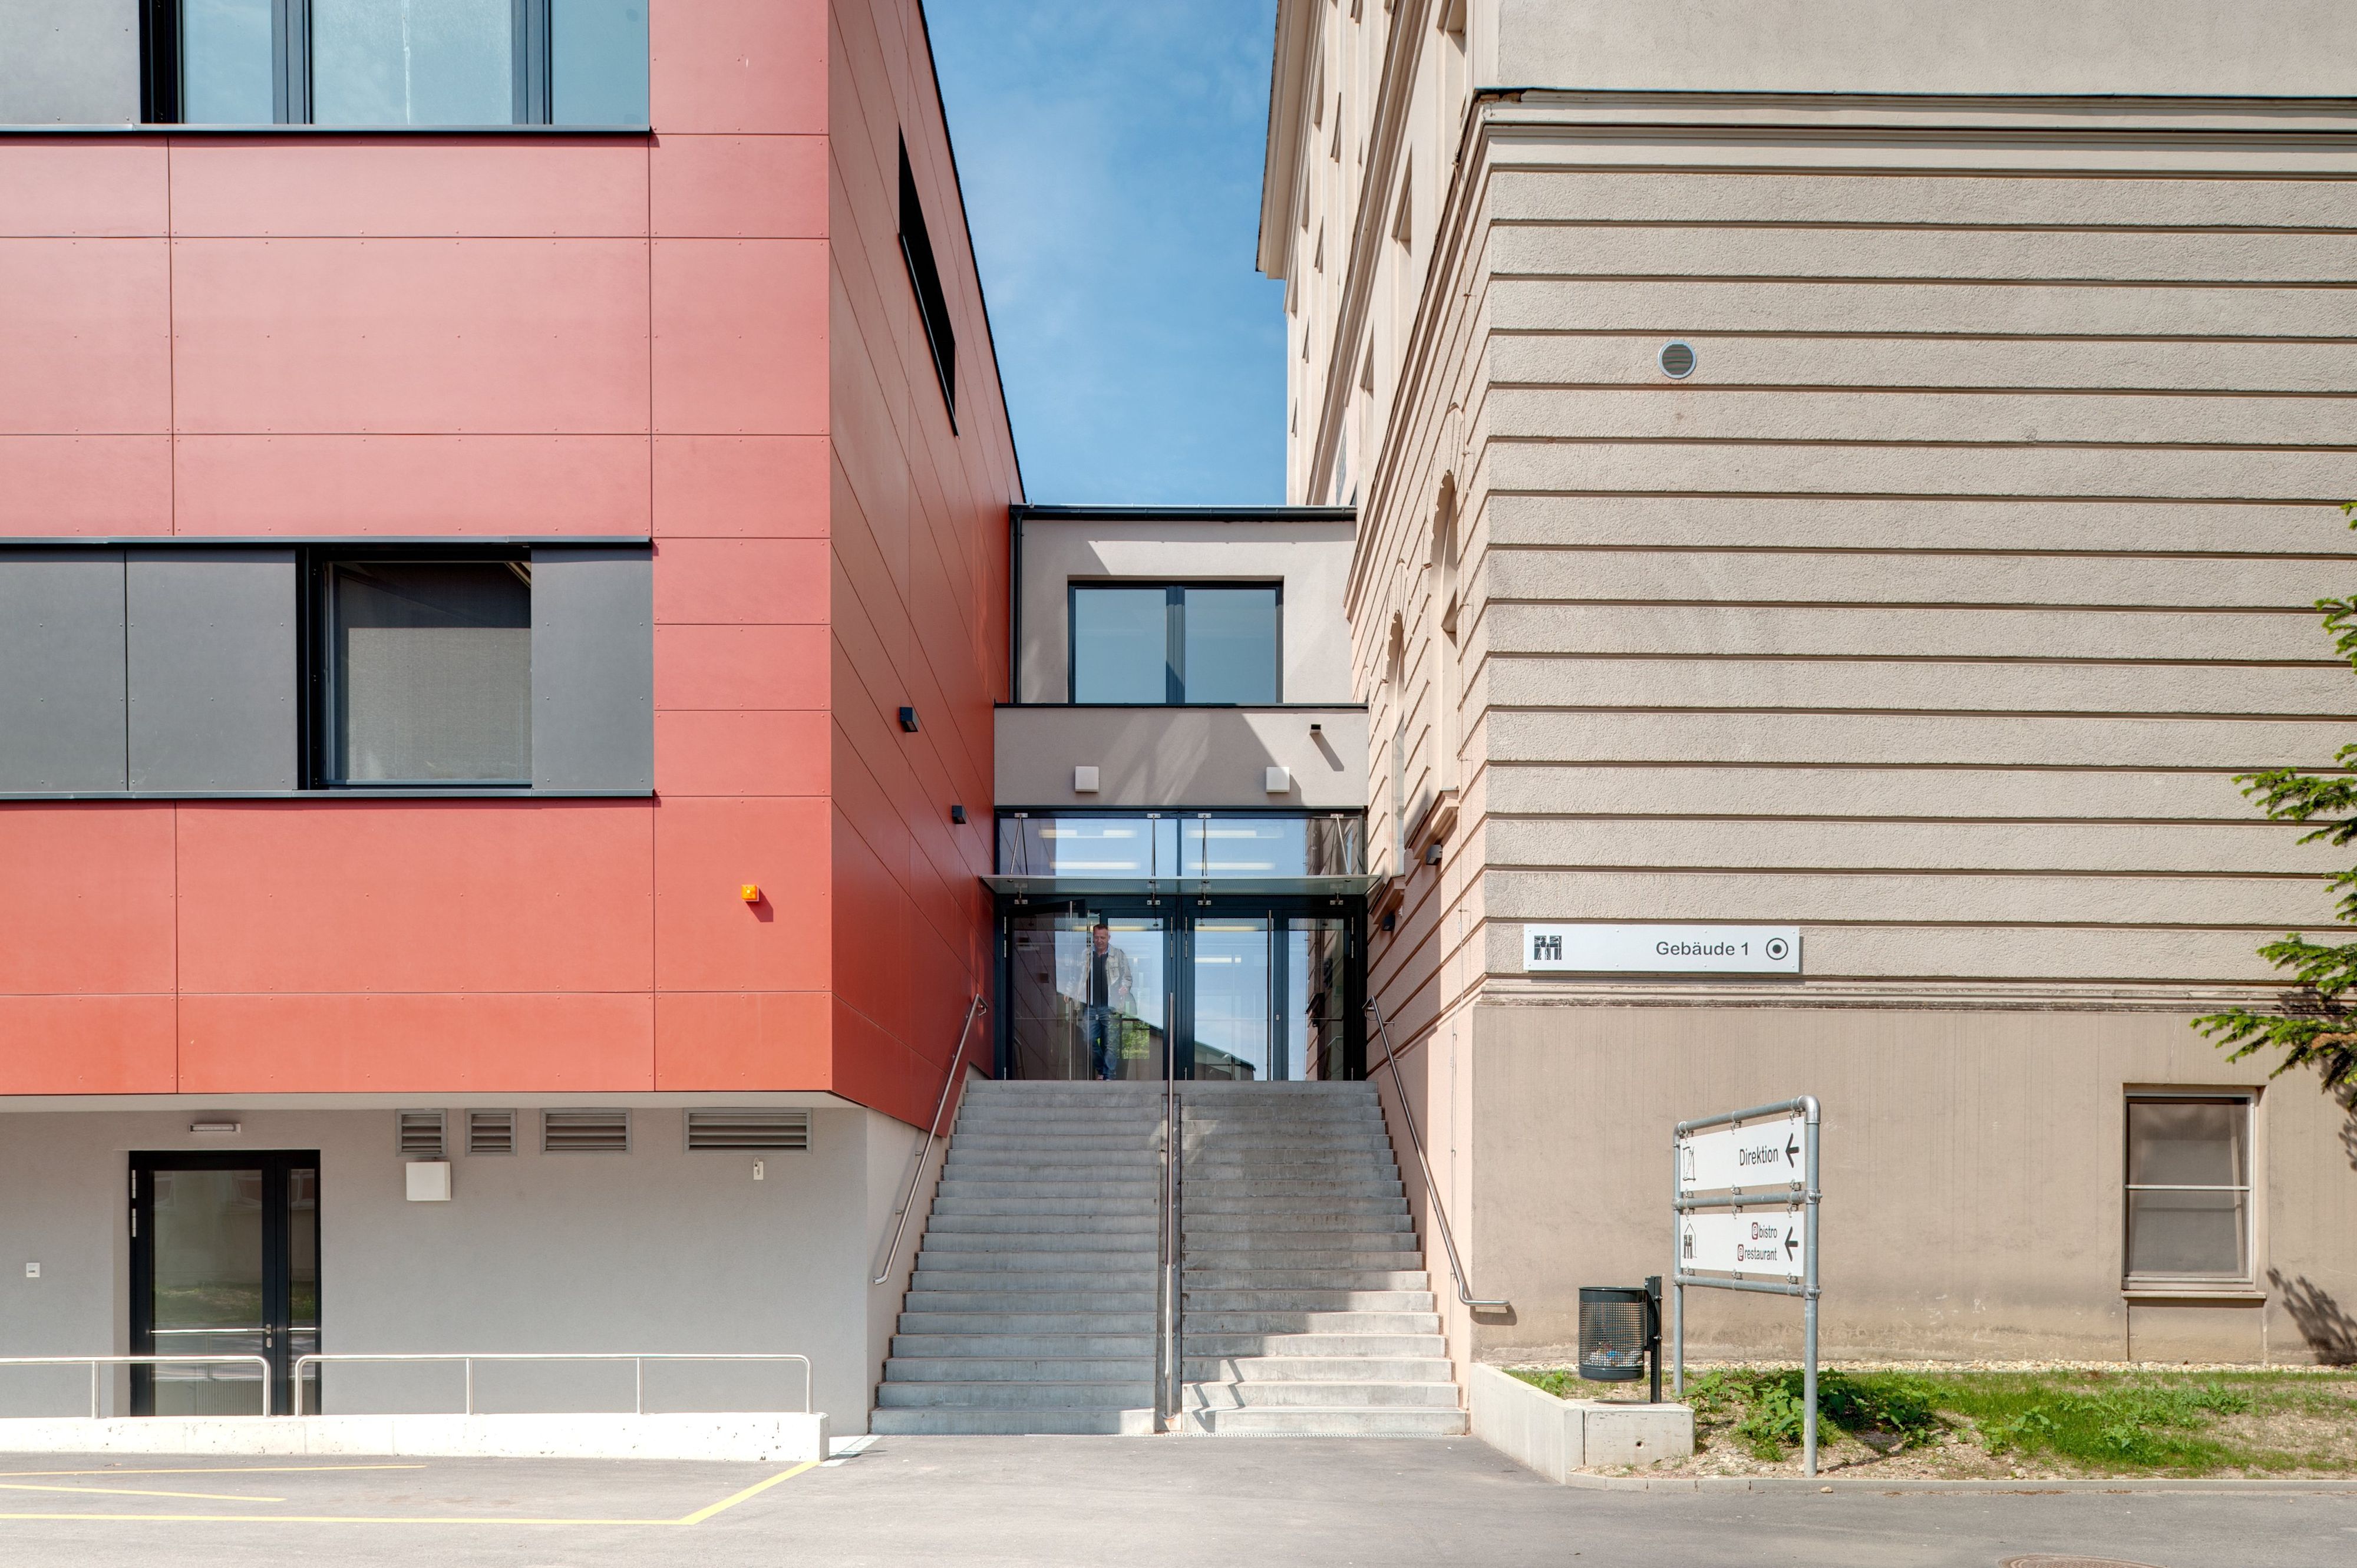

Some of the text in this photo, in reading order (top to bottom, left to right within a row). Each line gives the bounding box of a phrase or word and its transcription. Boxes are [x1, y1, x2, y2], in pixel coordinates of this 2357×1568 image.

[1656, 941, 1749, 956] Gebäude 1
[1739, 1144, 1778, 1166] Direktion
